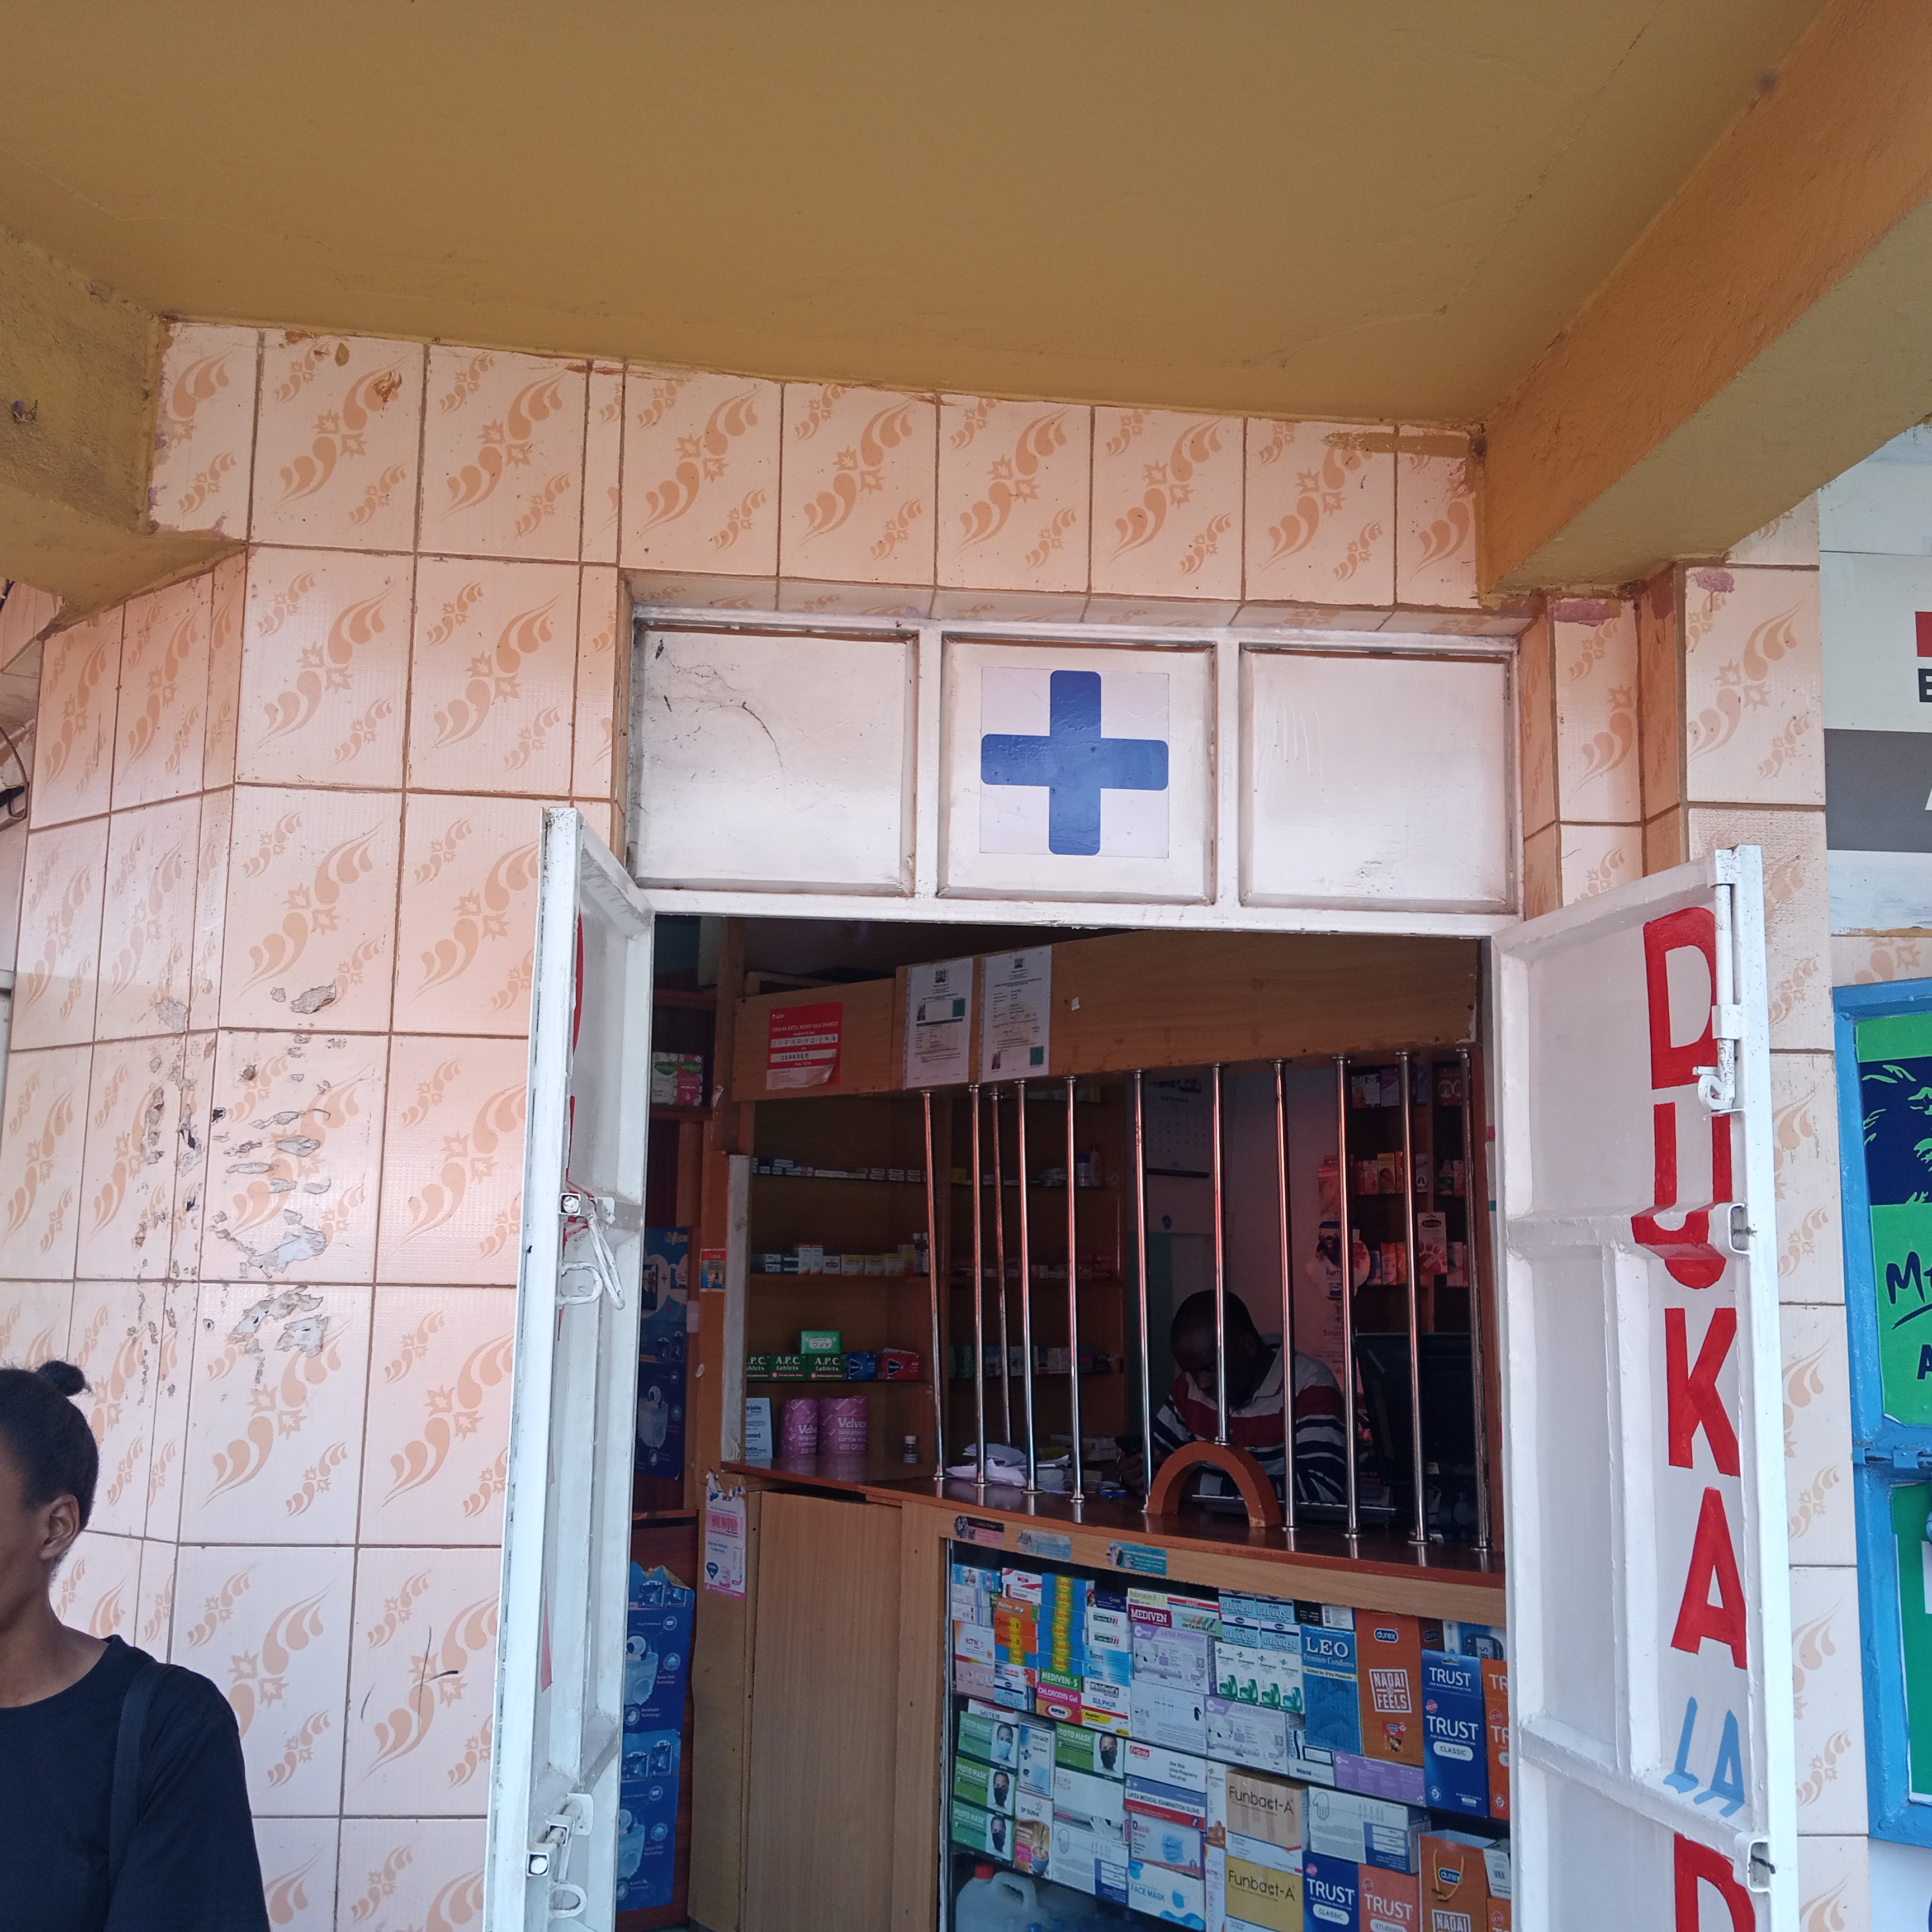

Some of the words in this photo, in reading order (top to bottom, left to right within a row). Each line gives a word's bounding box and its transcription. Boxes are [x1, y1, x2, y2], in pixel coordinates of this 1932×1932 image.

[1221, 1602, 1252, 1612] GLUCOSE
[1258, 1608, 1291, 1620] GLUCOSE
[1130, 1608, 1167, 1623] MEDIVEN
[1224, 1630, 1256, 1642] GLUCOSE
[1265, 1637, 1298, 1650] GLUCOSE
[1376, 1631, 1396, 1641] durex
[1306, 1636, 1349, 1658] LEO
[1303, 1653, 1327, 1664] Premium
[1327, 1658, 1355, 1668] Condoms
[1429, 1667, 1471, 1687] TRUST
[1069, 1694, 1078, 1703] Gel
[1093, 1697, 1117, 1708] SULPHUR
[1377, 1694, 1408, 1709] FEELS
[1426, 1715, 1479, 1740] TRUST
[1075, 1732, 1092, 1743] MASK
[1440, 1746, 1467, 1756] CLASSIC
[1663, 1697, 1745, 1817] LA
[1229, 1786, 1294, 1815] Funbact-A
[1130, 1883, 1147, 1896] FACE
[1147, 1890, 1165, 1902] MASK
[1228, 1870, 1295, 1901] Funbact-A
[1307, 1878, 1355, 1905] TRUST
[1365, 1893, 1413, 1920] TRUST
[1319, 1909, 1342, 1920] CLASSIC
